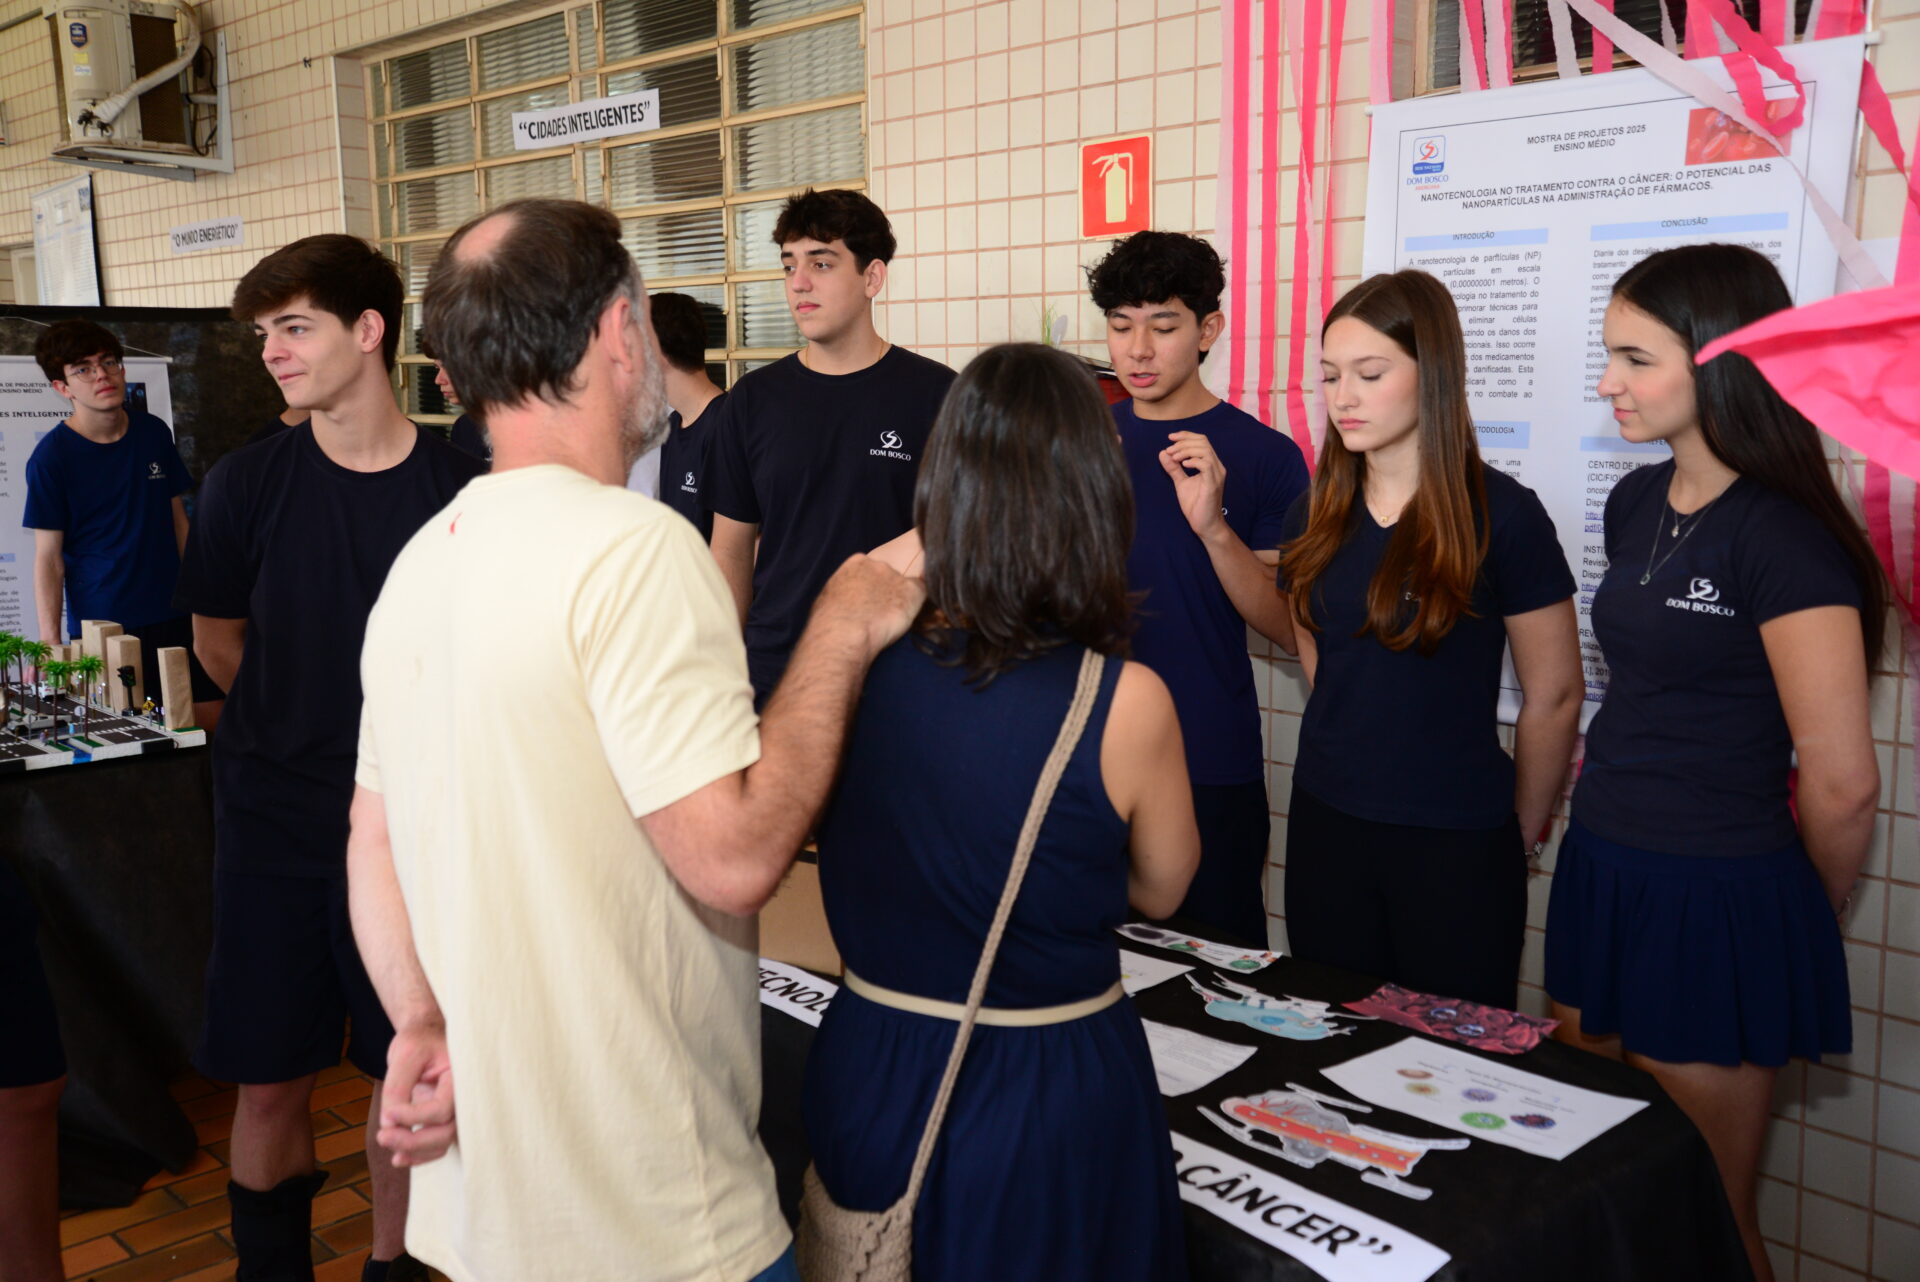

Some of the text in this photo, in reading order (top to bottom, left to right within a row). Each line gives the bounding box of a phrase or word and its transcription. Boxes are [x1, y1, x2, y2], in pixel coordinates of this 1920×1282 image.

[518, 100, 650, 140] “CIDADES INTELIGENTES”
[1527, 124, 1646, 145] MOSTRA DE PROJETOS 2025
[1554, 138, 1616, 152] ENSINO MÉDIO
[1420, 186, 1498, 202] NANOTECNOLOGIA
[1500, 186, 1513, 195] NO
[1515, 181, 1574, 194] TRATAMENTO
[1576, 176, 1616, 188] CONTRA
[1618, 176, 1626, 186] O
[1628, 172, 1672, 184] CÂNCER:
[1675, 171, 1684, 180] O
[1686, 166, 1745, 180] POTENCIAL
[1748, 163, 1772, 174] DAS
[1462, 180, 1713, 210] NANOPARTÍCULAS NA ADMINISTRAÇÃO DE FÁRMACOS.
[1661, 217, 1708, 228] CONCLUSÃO
[1452, 230, 1495, 240] INTRODUÇÃO
[1418, 256, 1466, 266] nanotecnologia
[1524, 251, 1542, 260] (NP)
[1443, 268, 1476, 276] partículas
[1518, 264, 1541, 272] escala
[1452, 292, 1476, 301] nologia
[1490, 291, 1528, 299] tratamento
[1457, 304, 1486, 312] primorar
[1463, 328, 1484, 336] uzindo
[1488, 390, 1518, 398] combate
[1474, 426, 1515, 434] ETODOLOGIA
[870, 448, 912, 462] DOM BOSCO
[1588, 460, 1621, 470] CENTRO
[1622, 462, 1633, 470] DE
[1665, 598, 1736, 617] DOM BOSCO
[1177, 1164, 1393, 1257] CÂNCER”
